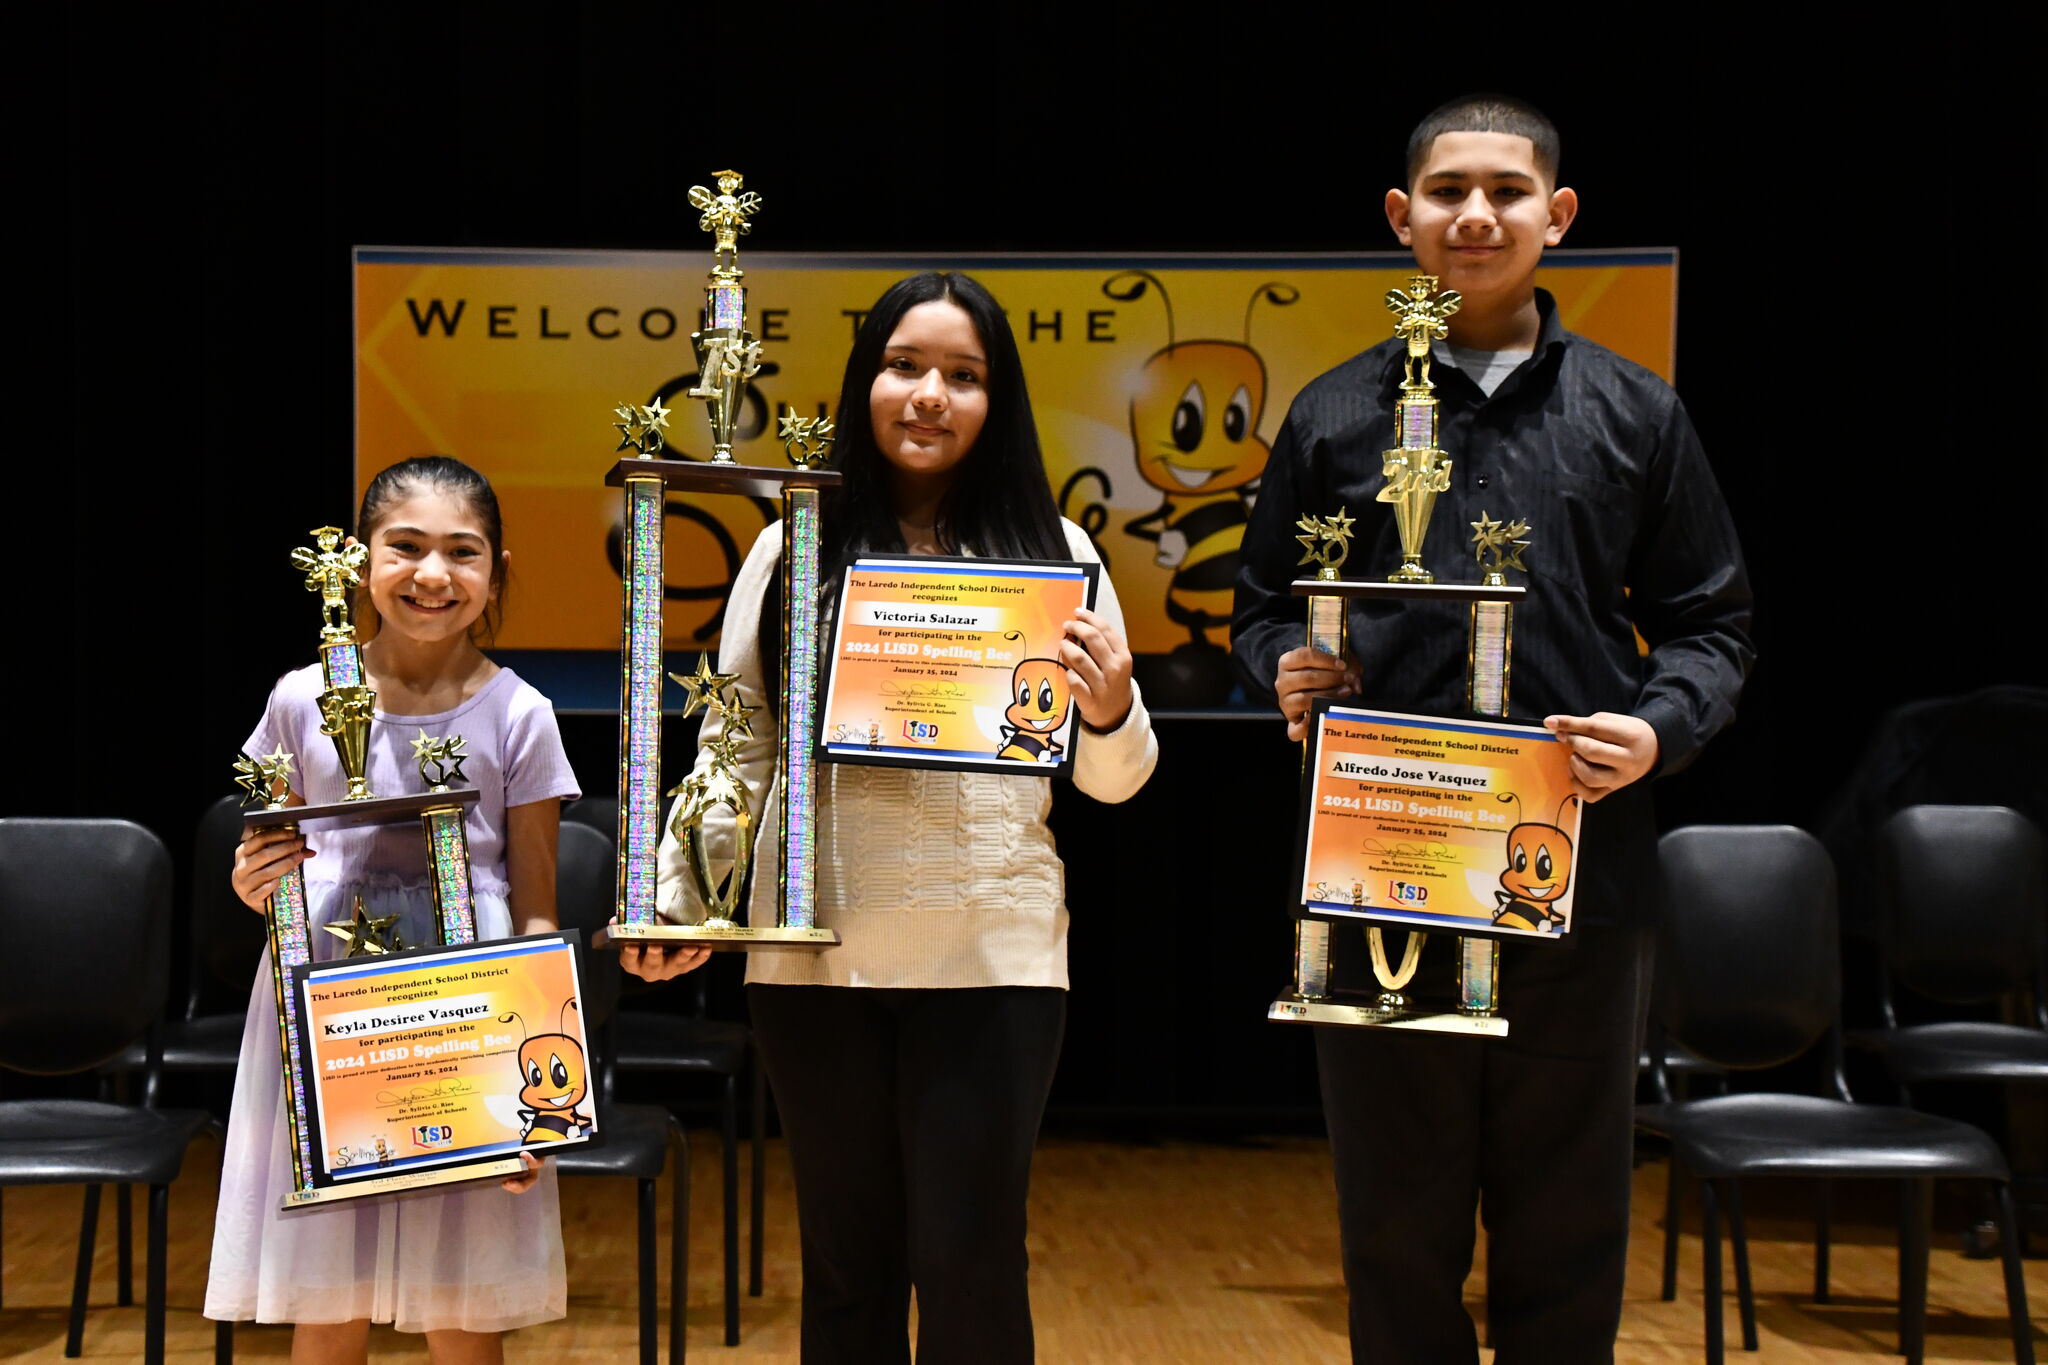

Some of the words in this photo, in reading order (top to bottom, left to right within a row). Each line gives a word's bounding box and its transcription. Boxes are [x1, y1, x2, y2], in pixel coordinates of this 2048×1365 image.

[405, 298, 790, 340] WELCOE
[1029, 309, 1117, 343] HE
[687, 337, 764, 399] 1st
[868, 580, 898, 589] Laredo
[900, 581, 956, 591] Independent
[958, 584, 988, 593] School
[990, 585, 1025, 594] District
[912, 594, 958, 602] recognizes
[873, 610, 926, 623] Victoria
[929, 613, 978, 625] Salazar
[878, 629, 892, 637] for
[894, 630, 953, 641] participating
[955, 633, 965, 641] in
[967, 634, 982, 642] the
[845, 641, 880, 655] 2024
[883, 641, 919, 656] LISD
[922, 643, 983, 662] Spelling
[985, 647, 1012, 660] Bee
[893, 666, 924, 675] January
[902, 719, 939, 743] LISD
[1324, 727, 1343, 737] The
[1345, 730, 1378, 741] Laredo
[1381, 734, 1442, 747] Independent
[1445, 740, 1478, 751] School
[1480, 744, 1519, 755] District
[1394, 748, 1446, 758] recognizes
[1332, 761, 1388, 776] Alfredo
[1391, 767, 1424, 780] Jose
[1427, 770, 1487, 787] Vasquez
[1358, 783, 1374, 792] for
[1376, 786, 1441, 800] participating
[1444, 791, 1454, 800] in
[1457, 793, 1473, 802] the
[1323, 795, 1361, 810] 2024
[1364, 797, 1404, 813] LISD
[1407, 801, 1473, 823] Spelling
[1477, 809, 1506, 824] Bee
[1376, 823, 1411, 835] January
[1414, 828, 1426, 836] 25,
[1428, 829, 1447, 838] 2024
[1368, 865, 1415, 875] Superintendent
[1387, 880, 1428, 905] LISD
[333, 988, 368, 999] Laredo
[370, 978, 433, 993] Independent
[435, 973, 469, 984] School
[471, 968, 509, 979] District
[387, 989, 439, 1002] recognizes
[324, 1021, 367, 1035] Keyla
[371, 1014, 425, 1028] Desiree
[429, 1004, 489, 1020] Vasquez
[359, 1039, 374, 1047] for
[378, 1029, 444, 1045] participating
[459, 1024, 475, 1032] the
[325, 1054, 366, 1071] 2024
[368, 1046, 409, 1064] LISD
[413, 1039, 480, 1058] Spelling
[483, 1034, 512, 1047] Bee
[385, 1071, 421, 1081] January
[438, 1065, 458, 1074] 2024
[387, 1112, 435, 1123] Superintendent
[444, 1106, 467, 1114] Schools
[411, 1125, 453, 1148] LISD
